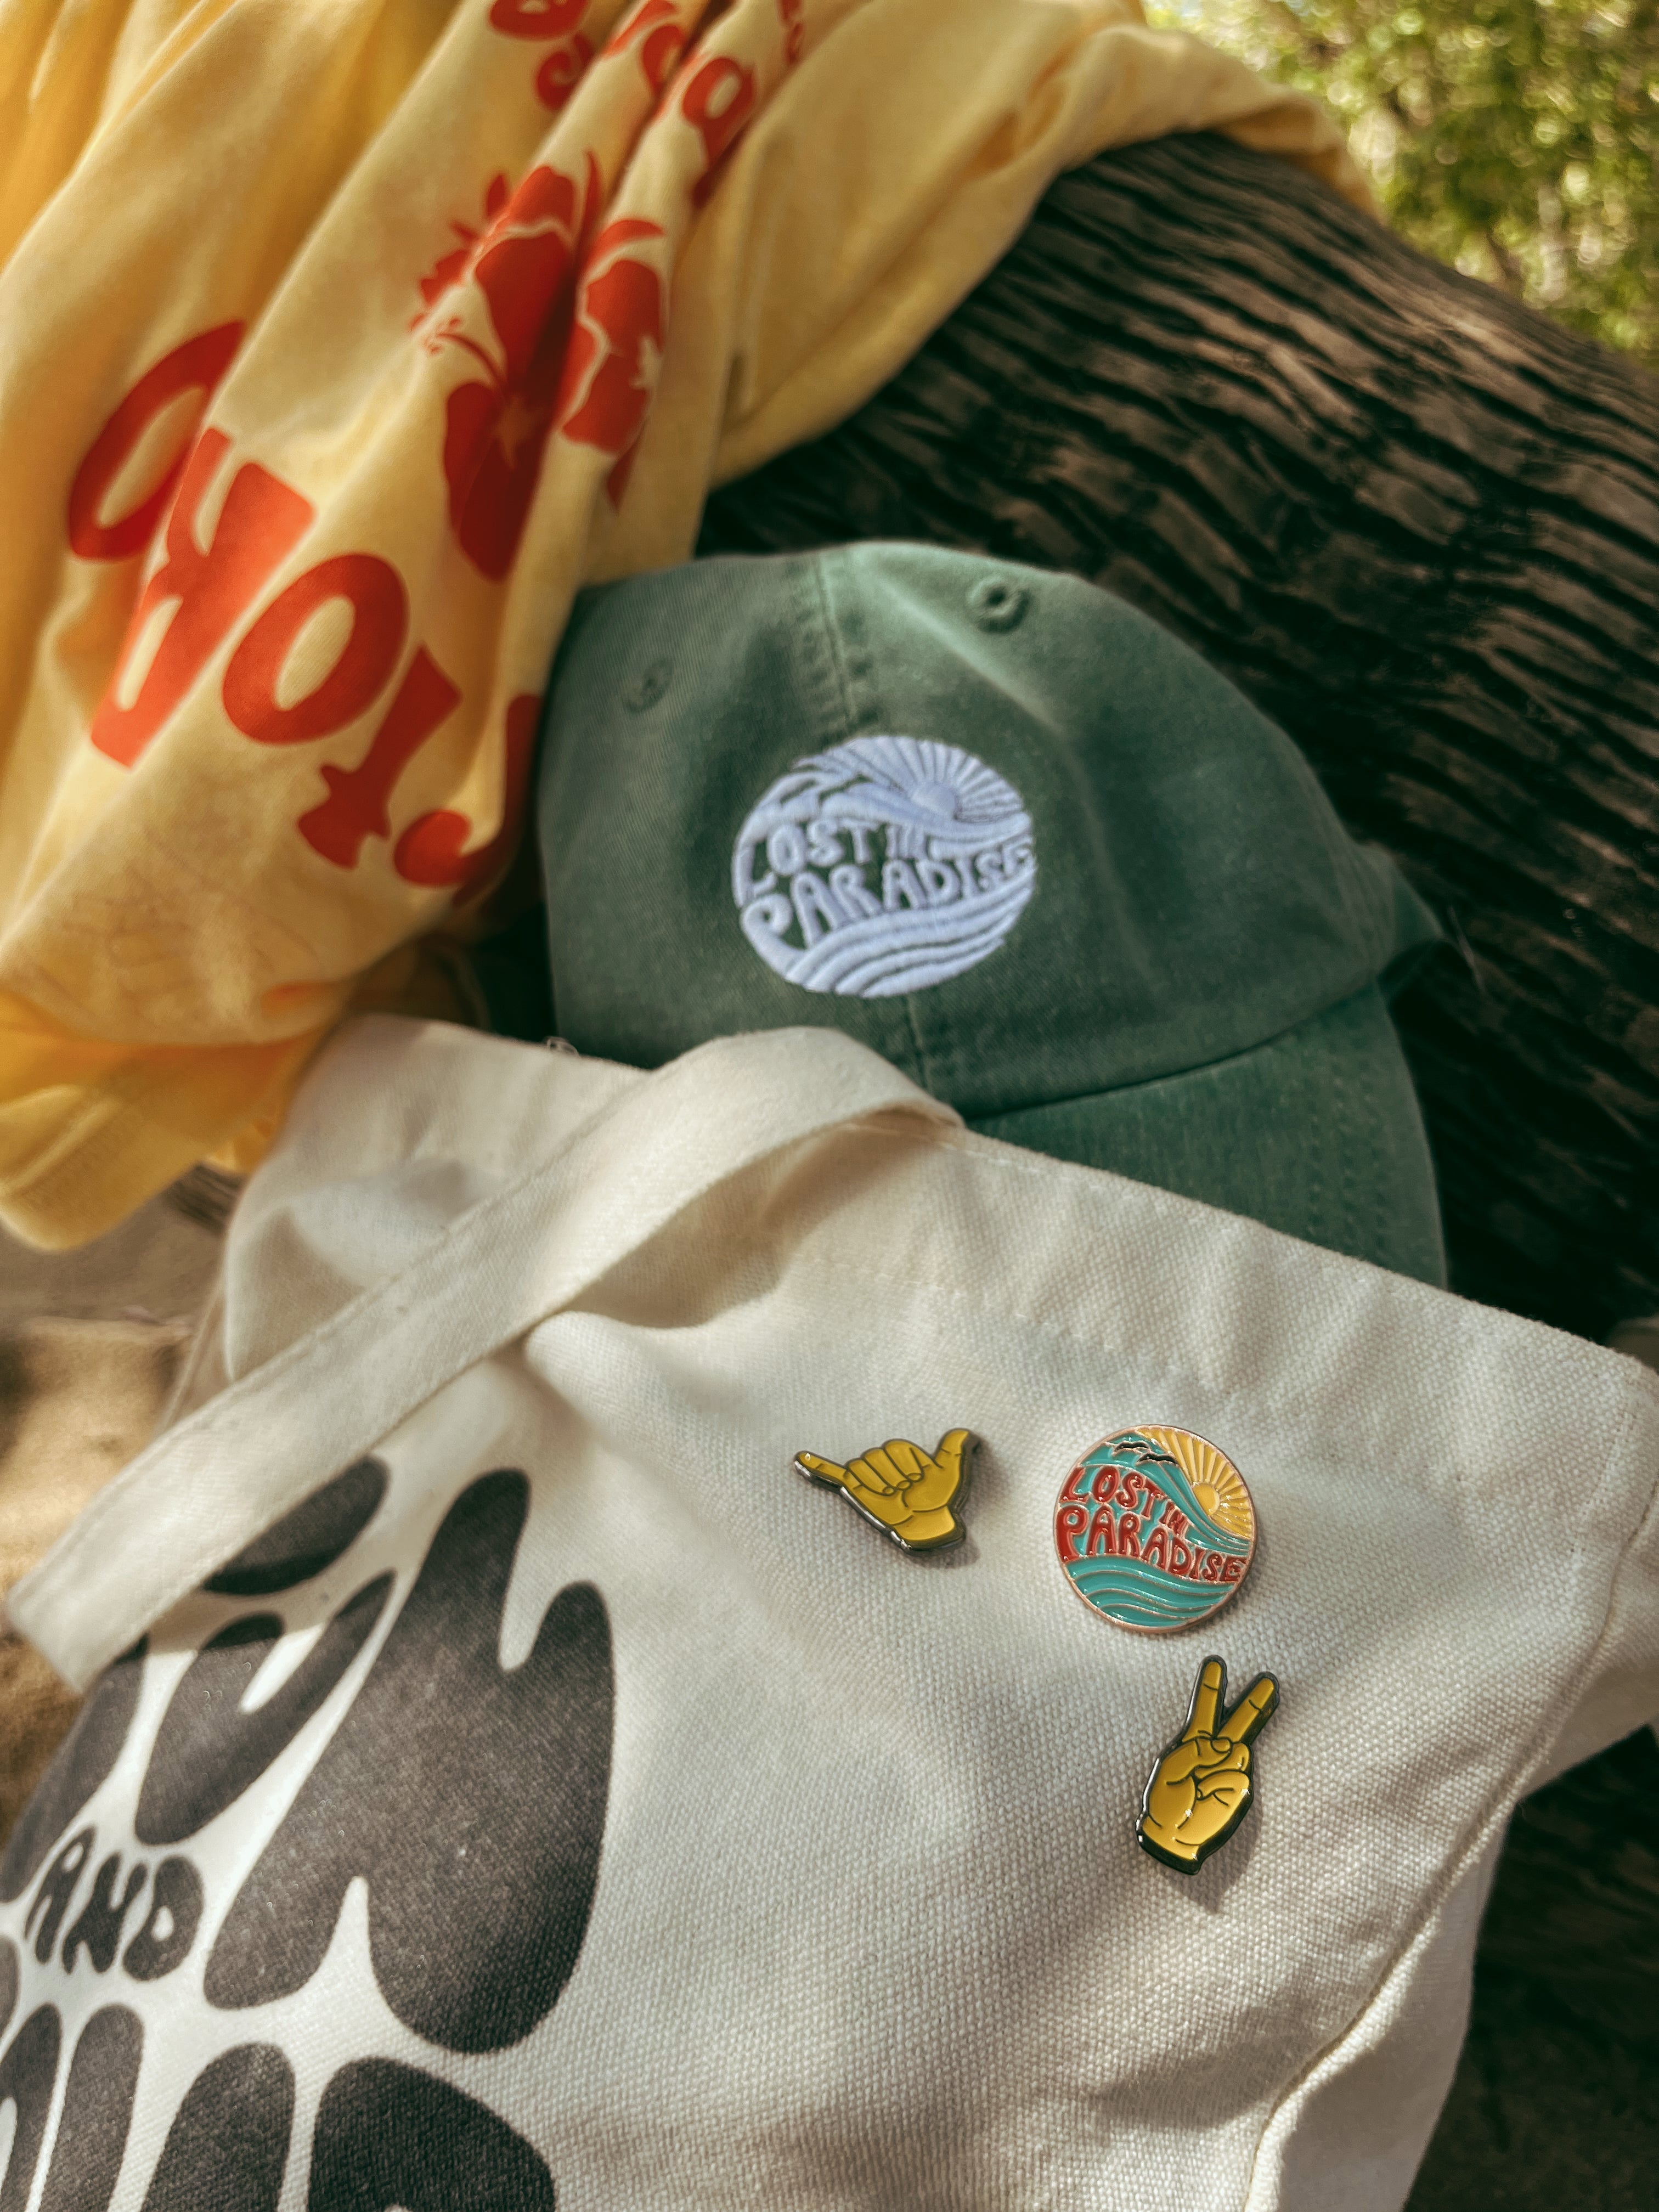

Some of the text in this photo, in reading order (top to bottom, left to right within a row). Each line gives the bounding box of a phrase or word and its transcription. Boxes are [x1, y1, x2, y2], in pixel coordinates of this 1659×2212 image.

[731, 813, 927, 909] LOST IN
[741, 833, 1036, 963] PARADISE
[1056, 1505, 1248, 1582] PARADISE
[1060, 1465, 1189, 1536] LOST IN
[24, 1823, 205, 1983] AND
